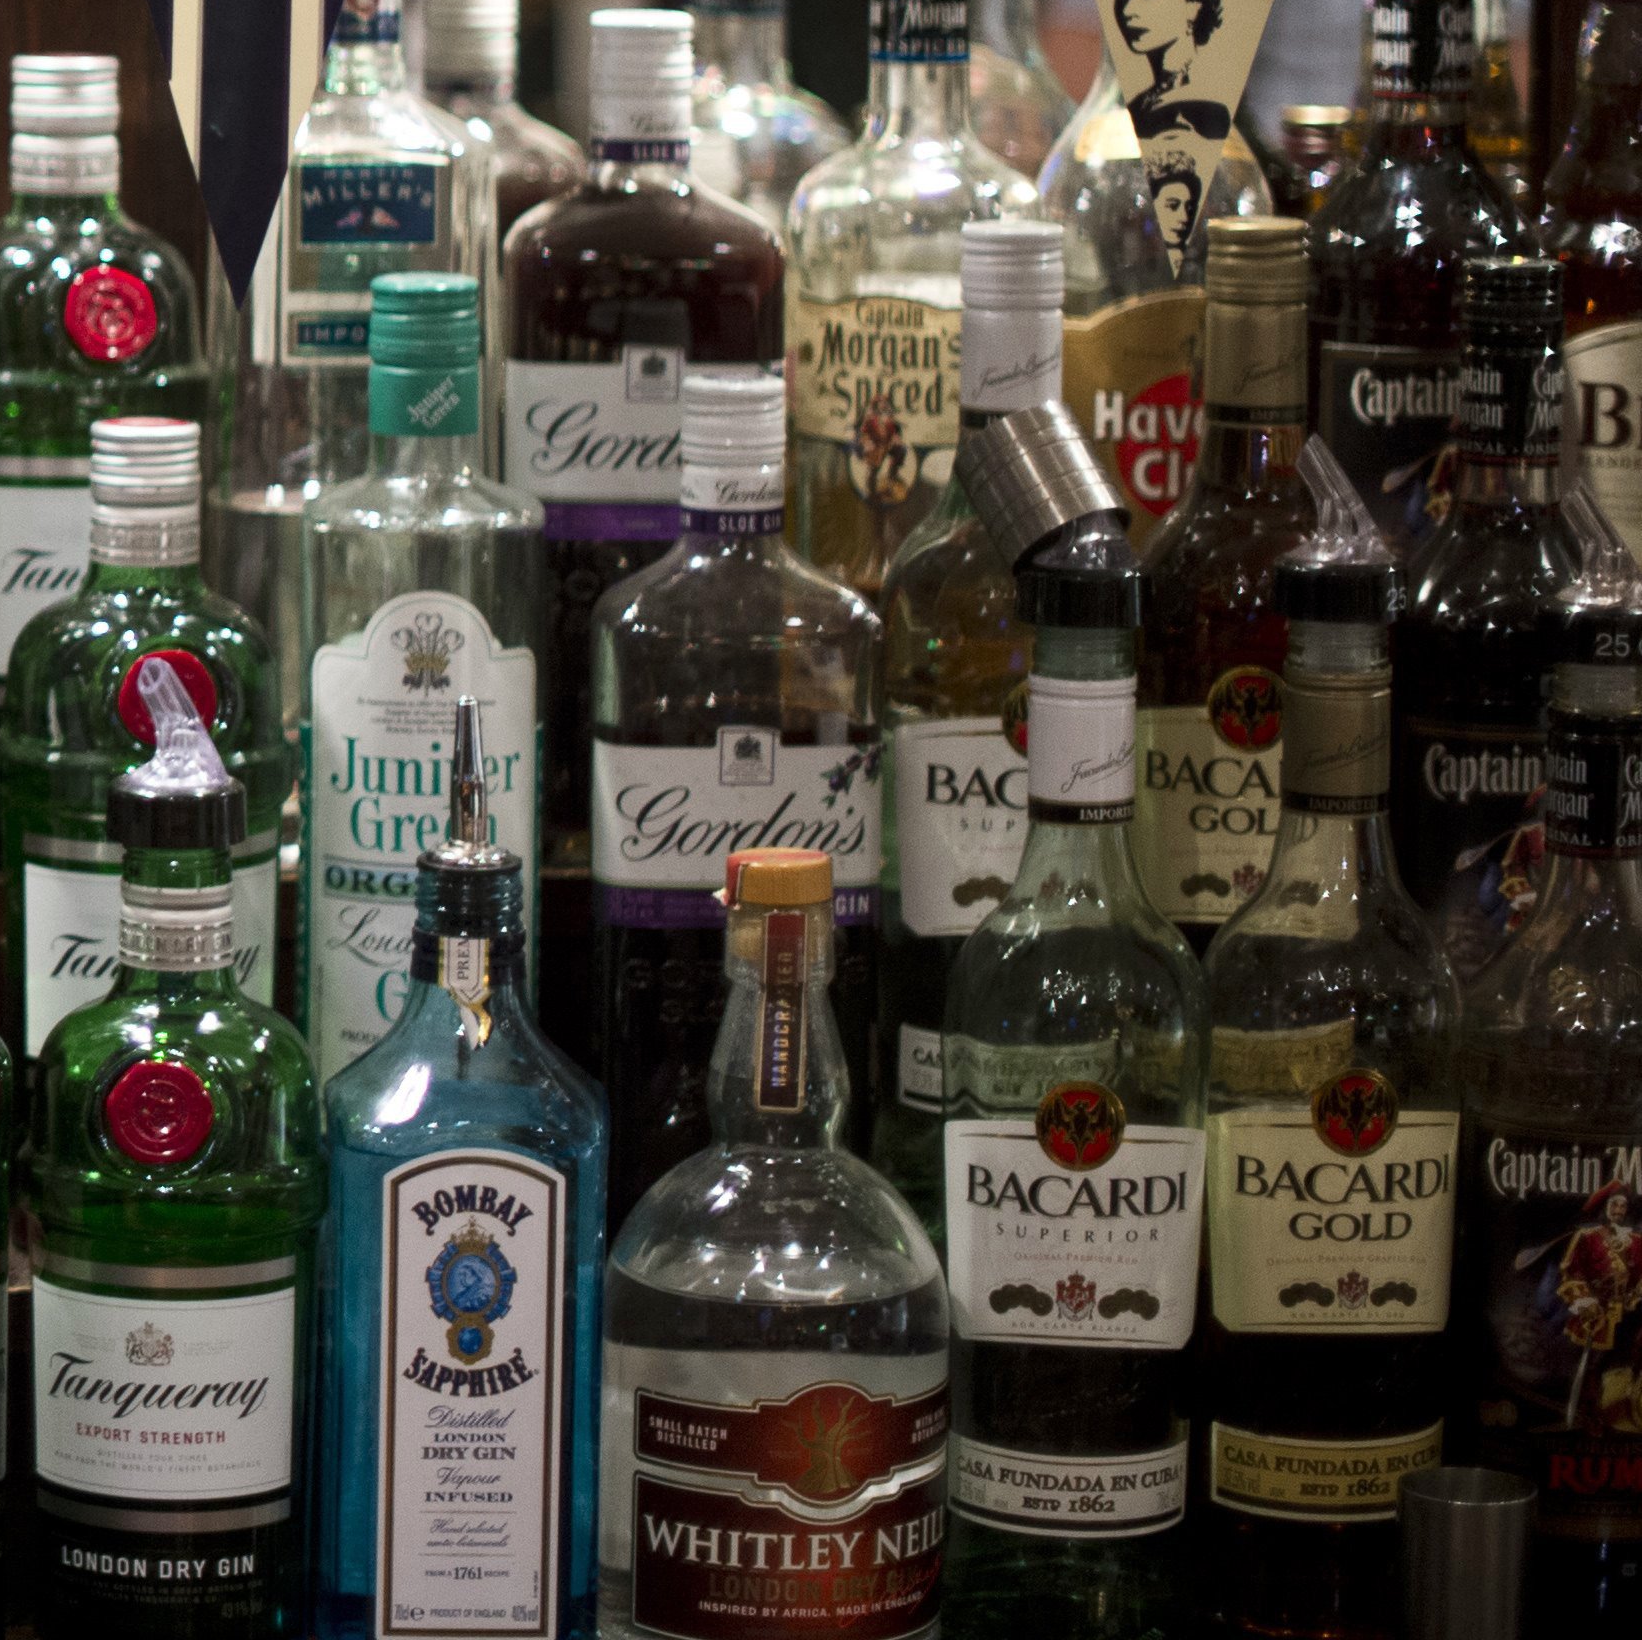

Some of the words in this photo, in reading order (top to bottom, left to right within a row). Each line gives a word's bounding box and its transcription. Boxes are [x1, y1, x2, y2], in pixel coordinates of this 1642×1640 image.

[303, 183, 433, 208] MILLER'S
[303, 324, 367, 343] IMPO
[527, 400, 682, 473] Gord
[1596, 632, 1630, 657] 25
[330, 735, 520, 796] Junier
[1424, 744, 1541, 803] Captain
[617, 782, 866, 862] Gordon's
[836, 894, 869, 916] GIN
[1236, 1153, 1450, 1206] BACARDI
[1488, 1138, 1601, 1200] Captain
[967, 1164, 1187, 1218] BACARDI
[412, 1184, 535, 1237] BOMBAY
[996, 1221, 1160, 1243] SUPERIOR
[1289, 1212, 1412, 1243] GOLD
[403, 1347, 536, 1398] SAPPHIRE
[48, 1352, 270, 1420] Tanqueray
[424, 1405, 516, 1429] Distilled
[649, 1415, 682, 1435] SMALL
[688, 1423, 727, 1440] BATCH
[76, 1422, 131, 1443] EXPORT
[140, 1430, 226, 1445] STRENGTH
[434, 1432, 506, 1444] LONDON
[657, 1431, 717, 1451] DISTILLED
[422, 1447, 468, 1461] DRY
[473, 1446, 517, 1461] GIN
[1225, 1445, 1269, 1472] CASA
[1275, 1456, 1380, 1477] FUNDADA
[437, 1466, 501, 1491] Vapour
[999, 1469, 1105, 1493] FUNDADA
[1110, 1473, 1137, 1491] EN
[1347, 1477, 1391, 1496] 1862
[425, 1491, 513, 1503] INFUSED
[1068, 1492, 1115, 1513] 1862
[644, 1514, 864, 1571] WHITLEY
[61, 1544, 147, 1579] LONDON
[159, 1559, 206, 1579] DRY
[218, 1555, 255, 1577] GIN
[454, 1566, 484, 1580] 1761
[699, 1600, 757, 1617] INSPIRED
[762, 1608, 778, 1617] BY
[782, 1607, 832, 1618] AFRICA.
[836, 1604, 867, 1617] MADE
[871, 1602, 882, 1612] IN
